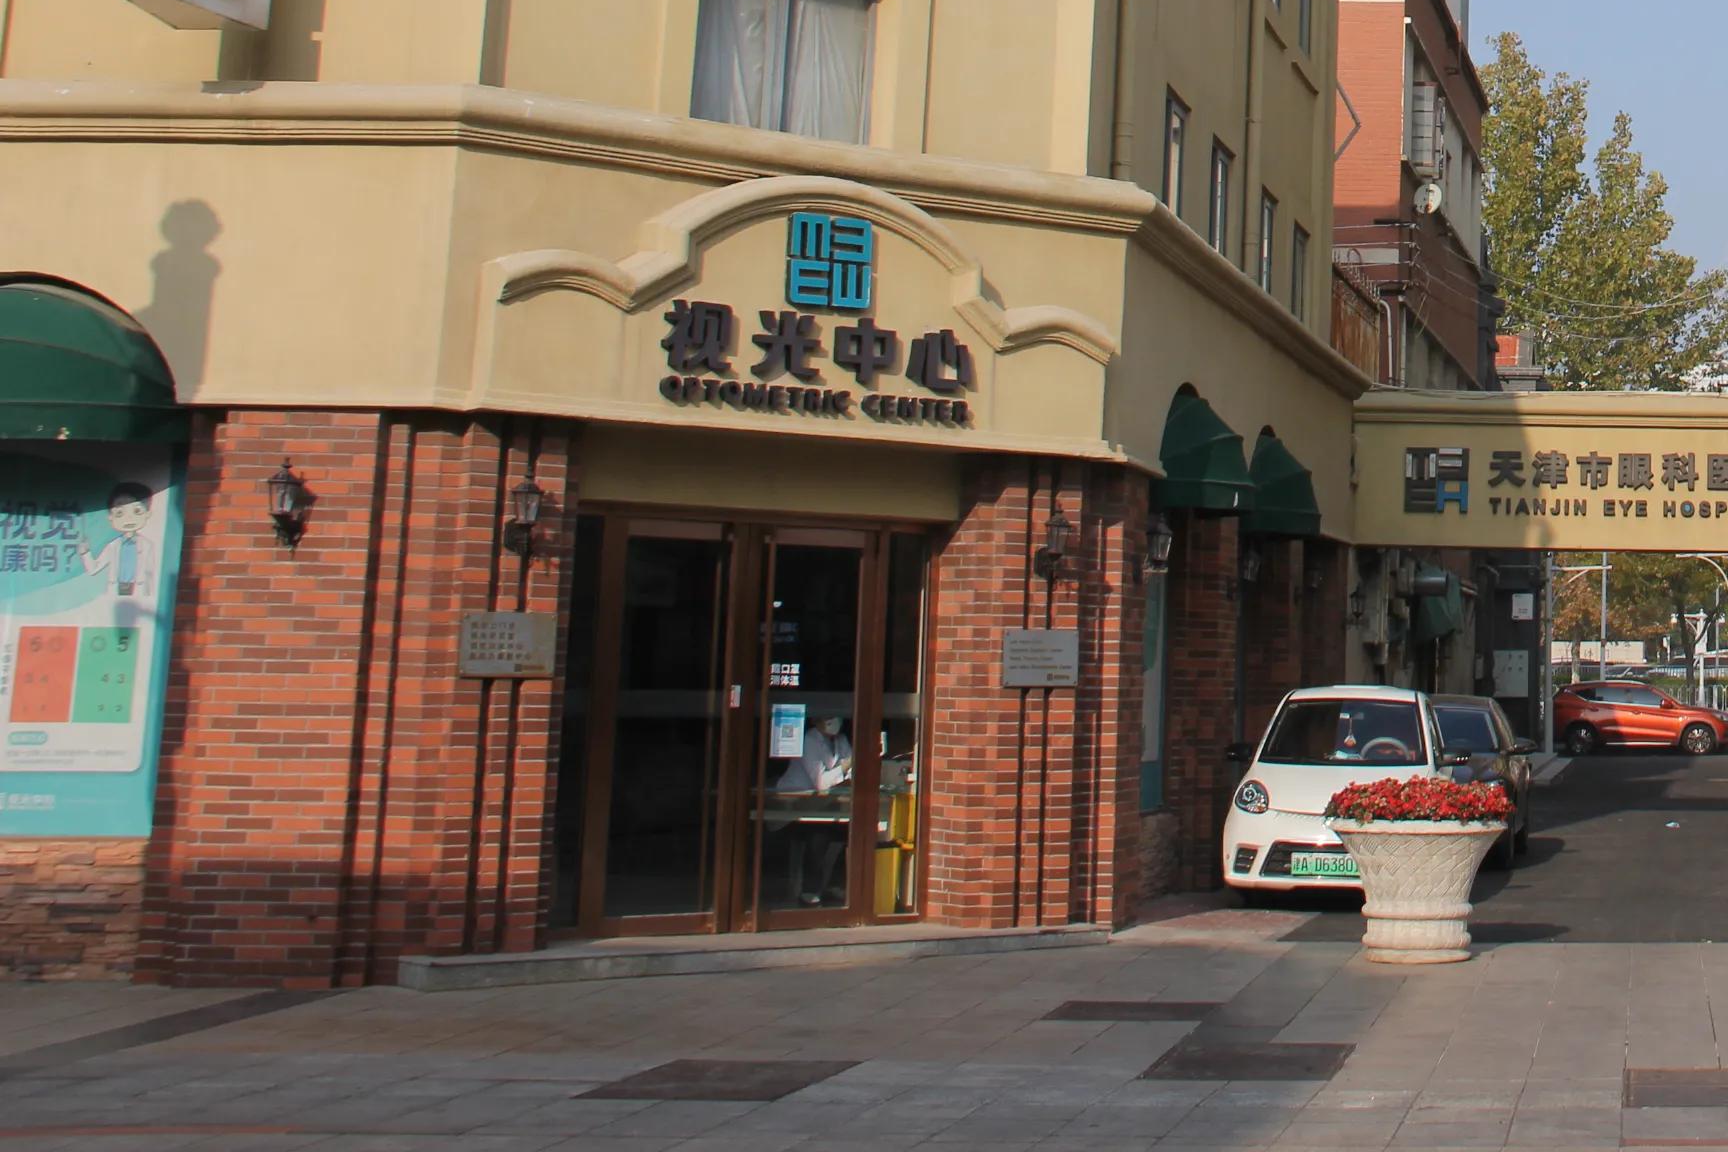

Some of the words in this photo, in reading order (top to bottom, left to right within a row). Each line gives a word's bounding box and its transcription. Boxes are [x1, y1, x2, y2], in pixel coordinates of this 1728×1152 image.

[660, 299, 973, 391] 视光中心
[659, 375, 853, 414] OPTOMETRIC
[860, 394, 972, 423] CENTER
[1488, 496, 1588, 517] TIANJIN
[1603, 498, 1649, 518] EYE
[1314, 857, 1358, 873] D6380
